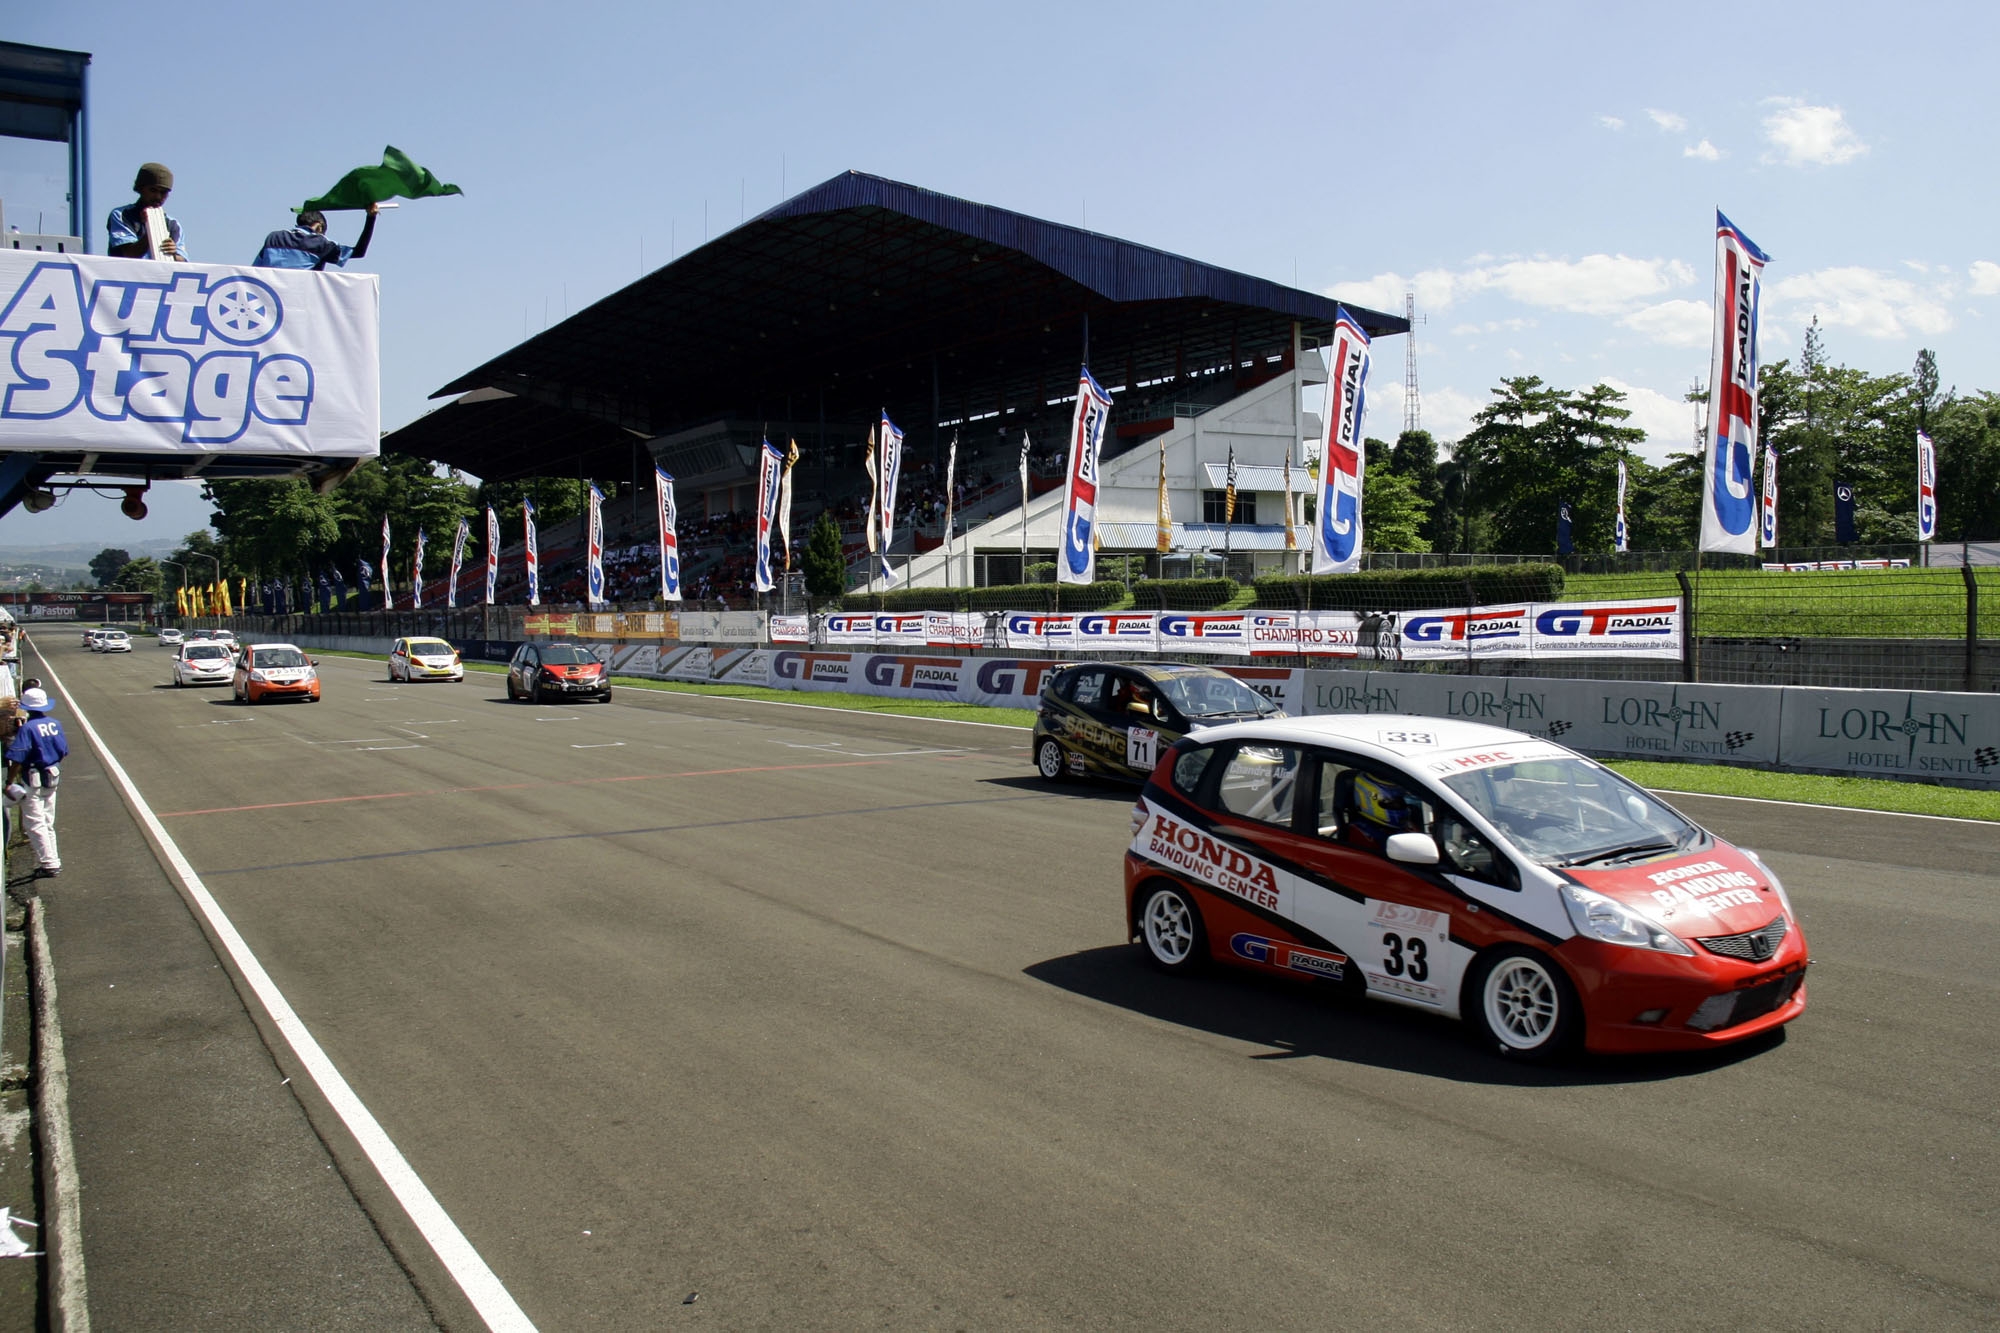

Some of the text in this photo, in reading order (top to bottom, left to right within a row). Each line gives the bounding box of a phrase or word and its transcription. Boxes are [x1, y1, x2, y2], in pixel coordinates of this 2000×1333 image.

[1738, 264, 1752, 383] RADIAL
[0, 328, 314, 443] Stage
[1342, 350, 1362, 442] RADIAL
[41, 605, 76, 616] Fastron
[1254, 616, 1290, 626] GT
[1536, 605, 1677, 636] GT RADIAL
[828, 615, 873, 632] GT
[876, 615, 924, 632] GT
[929, 624, 965, 637] CHAMPIRO
[1009, 616, 1073, 635] GT
[1079, 615, 1153, 635] GT RADIAL
[1159, 615, 1245, 637] GT RADIAL
[1404, 609, 1526, 641] GT RADIAL
[1254, 628, 1322, 643] CHAMPIRO
[774, 652, 852, 680] GT
[814, 664, 849, 675] RADIAL
[865, 655, 962, 688] GT RADIAL
[37, 722, 59, 737] RC
[1387, 731, 1431, 744] 33
[1133, 741, 1147, 762] 71
[1626, 736, 1671, 751] HOTEL
[1848, 751, 1904, 768] HOTEL
[1152, 814, 1280, 895] HONDA
[1149, 838, 1279, 912] BANDUNG CENTER
[1647, 861, 1729, 885] HONDA
[1650, 871, 1758, 907] BANDUNG
[1230, 932, 1347, 973] GT RADIAL
[1383, 932, 1428, 982] 33
